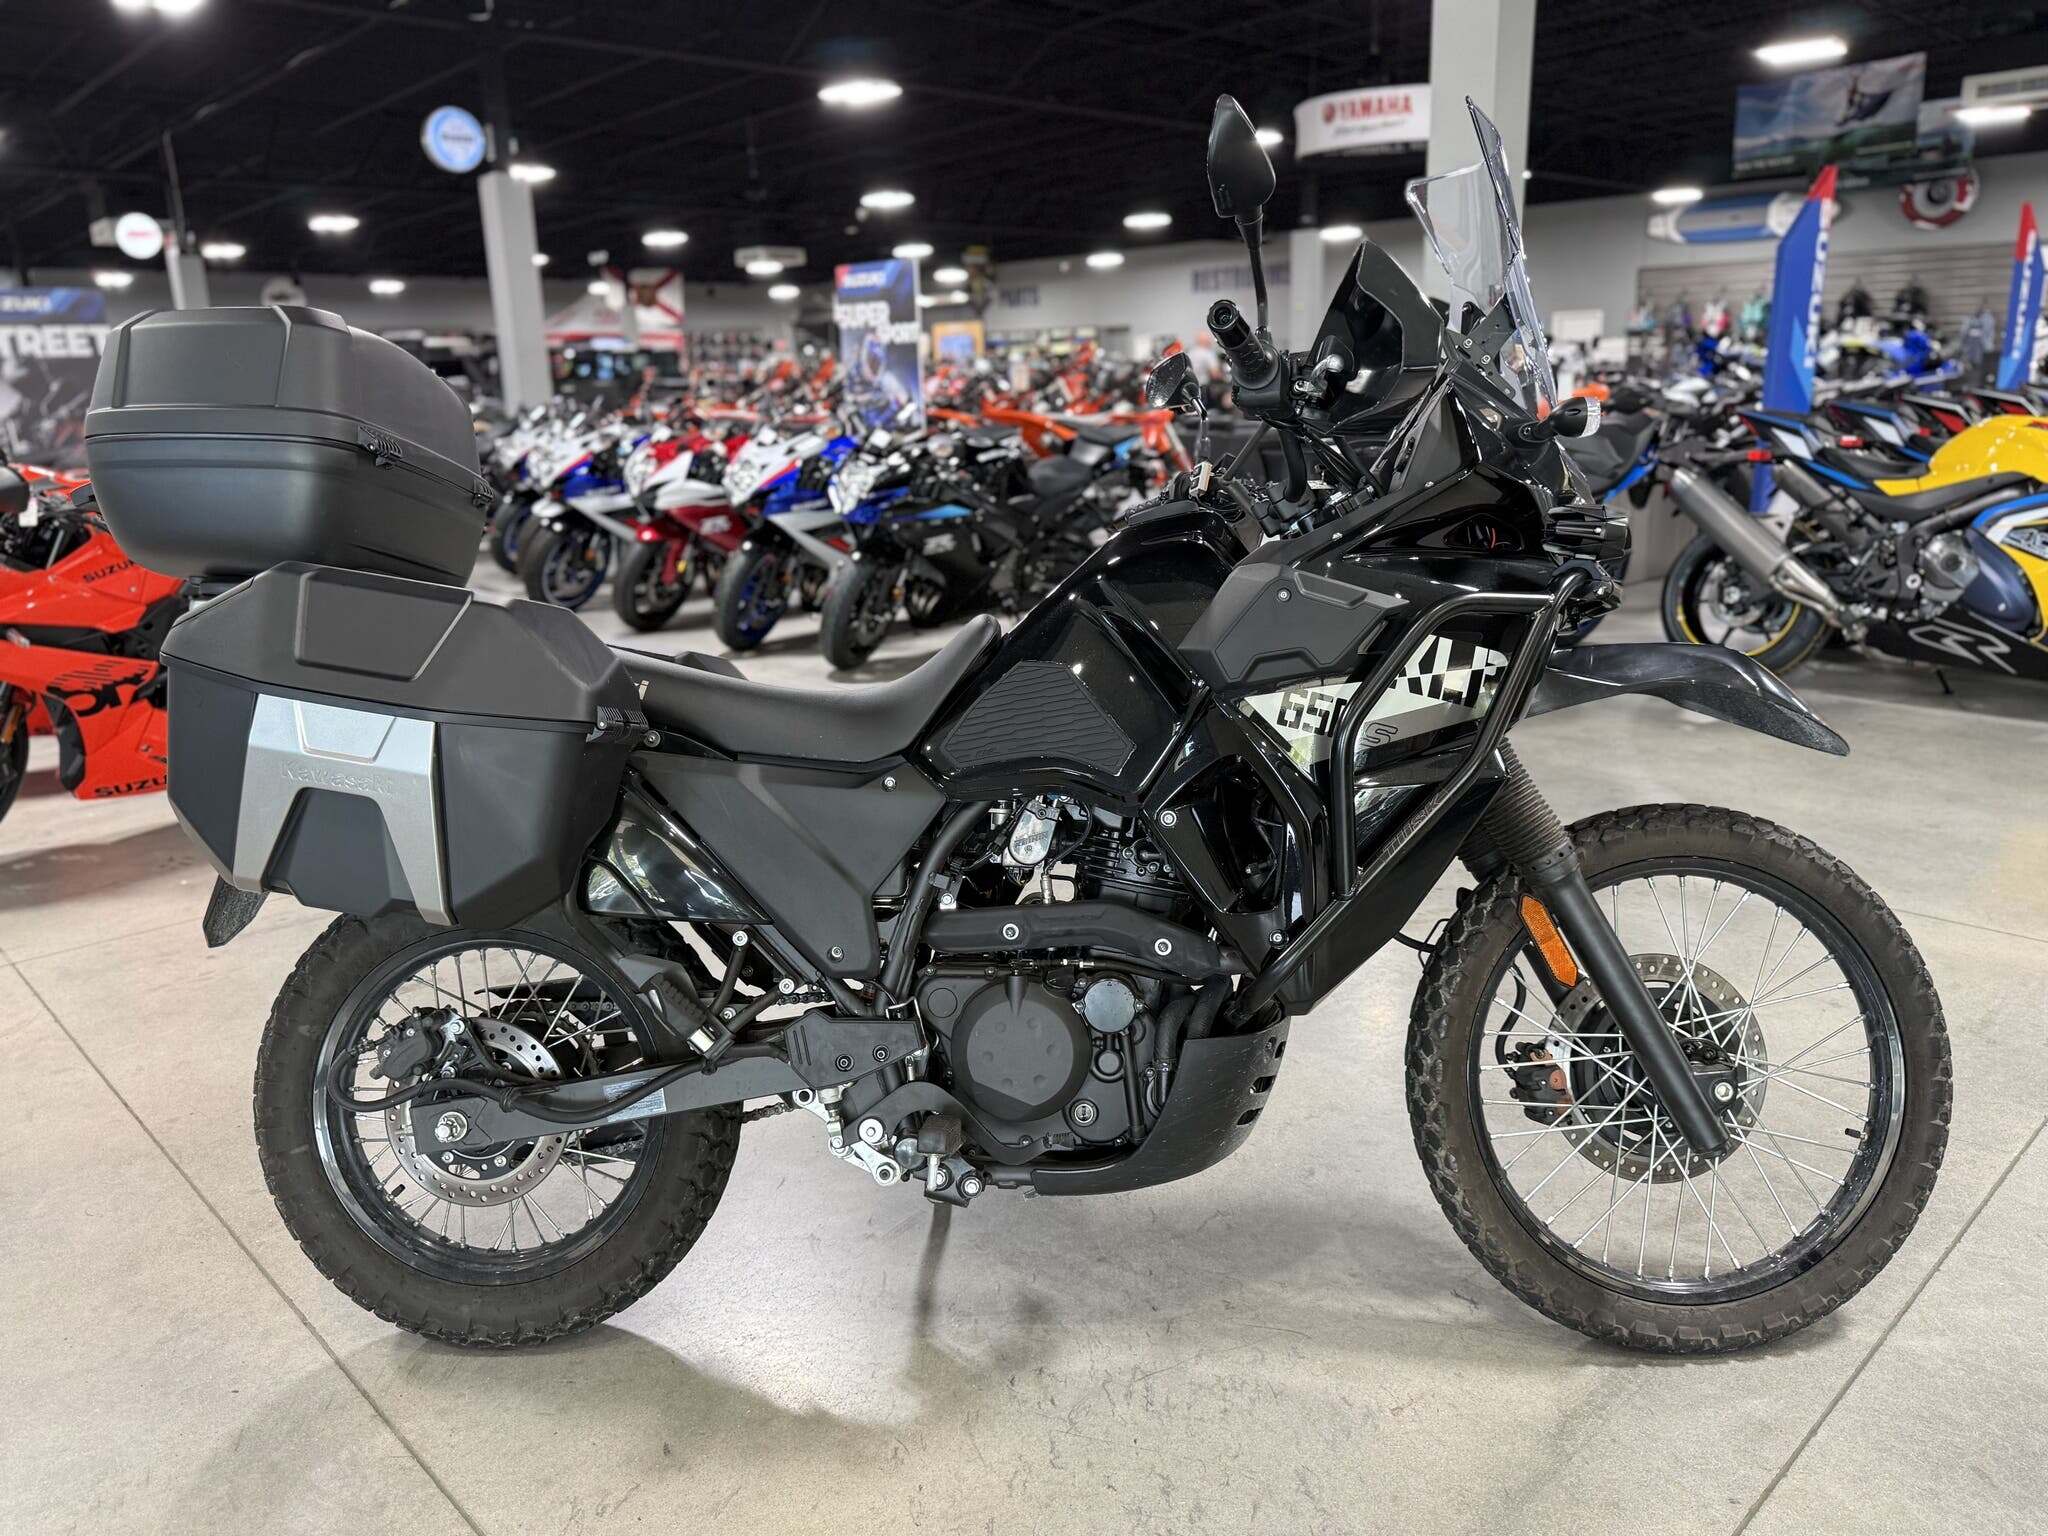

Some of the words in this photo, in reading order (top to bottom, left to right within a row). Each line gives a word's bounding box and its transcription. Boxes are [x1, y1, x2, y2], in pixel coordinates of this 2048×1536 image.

[1339, 94, 1413, 122] YAMAHA
[0, 325, 110, 359] TREET
[83, 559, 135, 583] SUZU
[95, 774, 168, 798] SUZU
